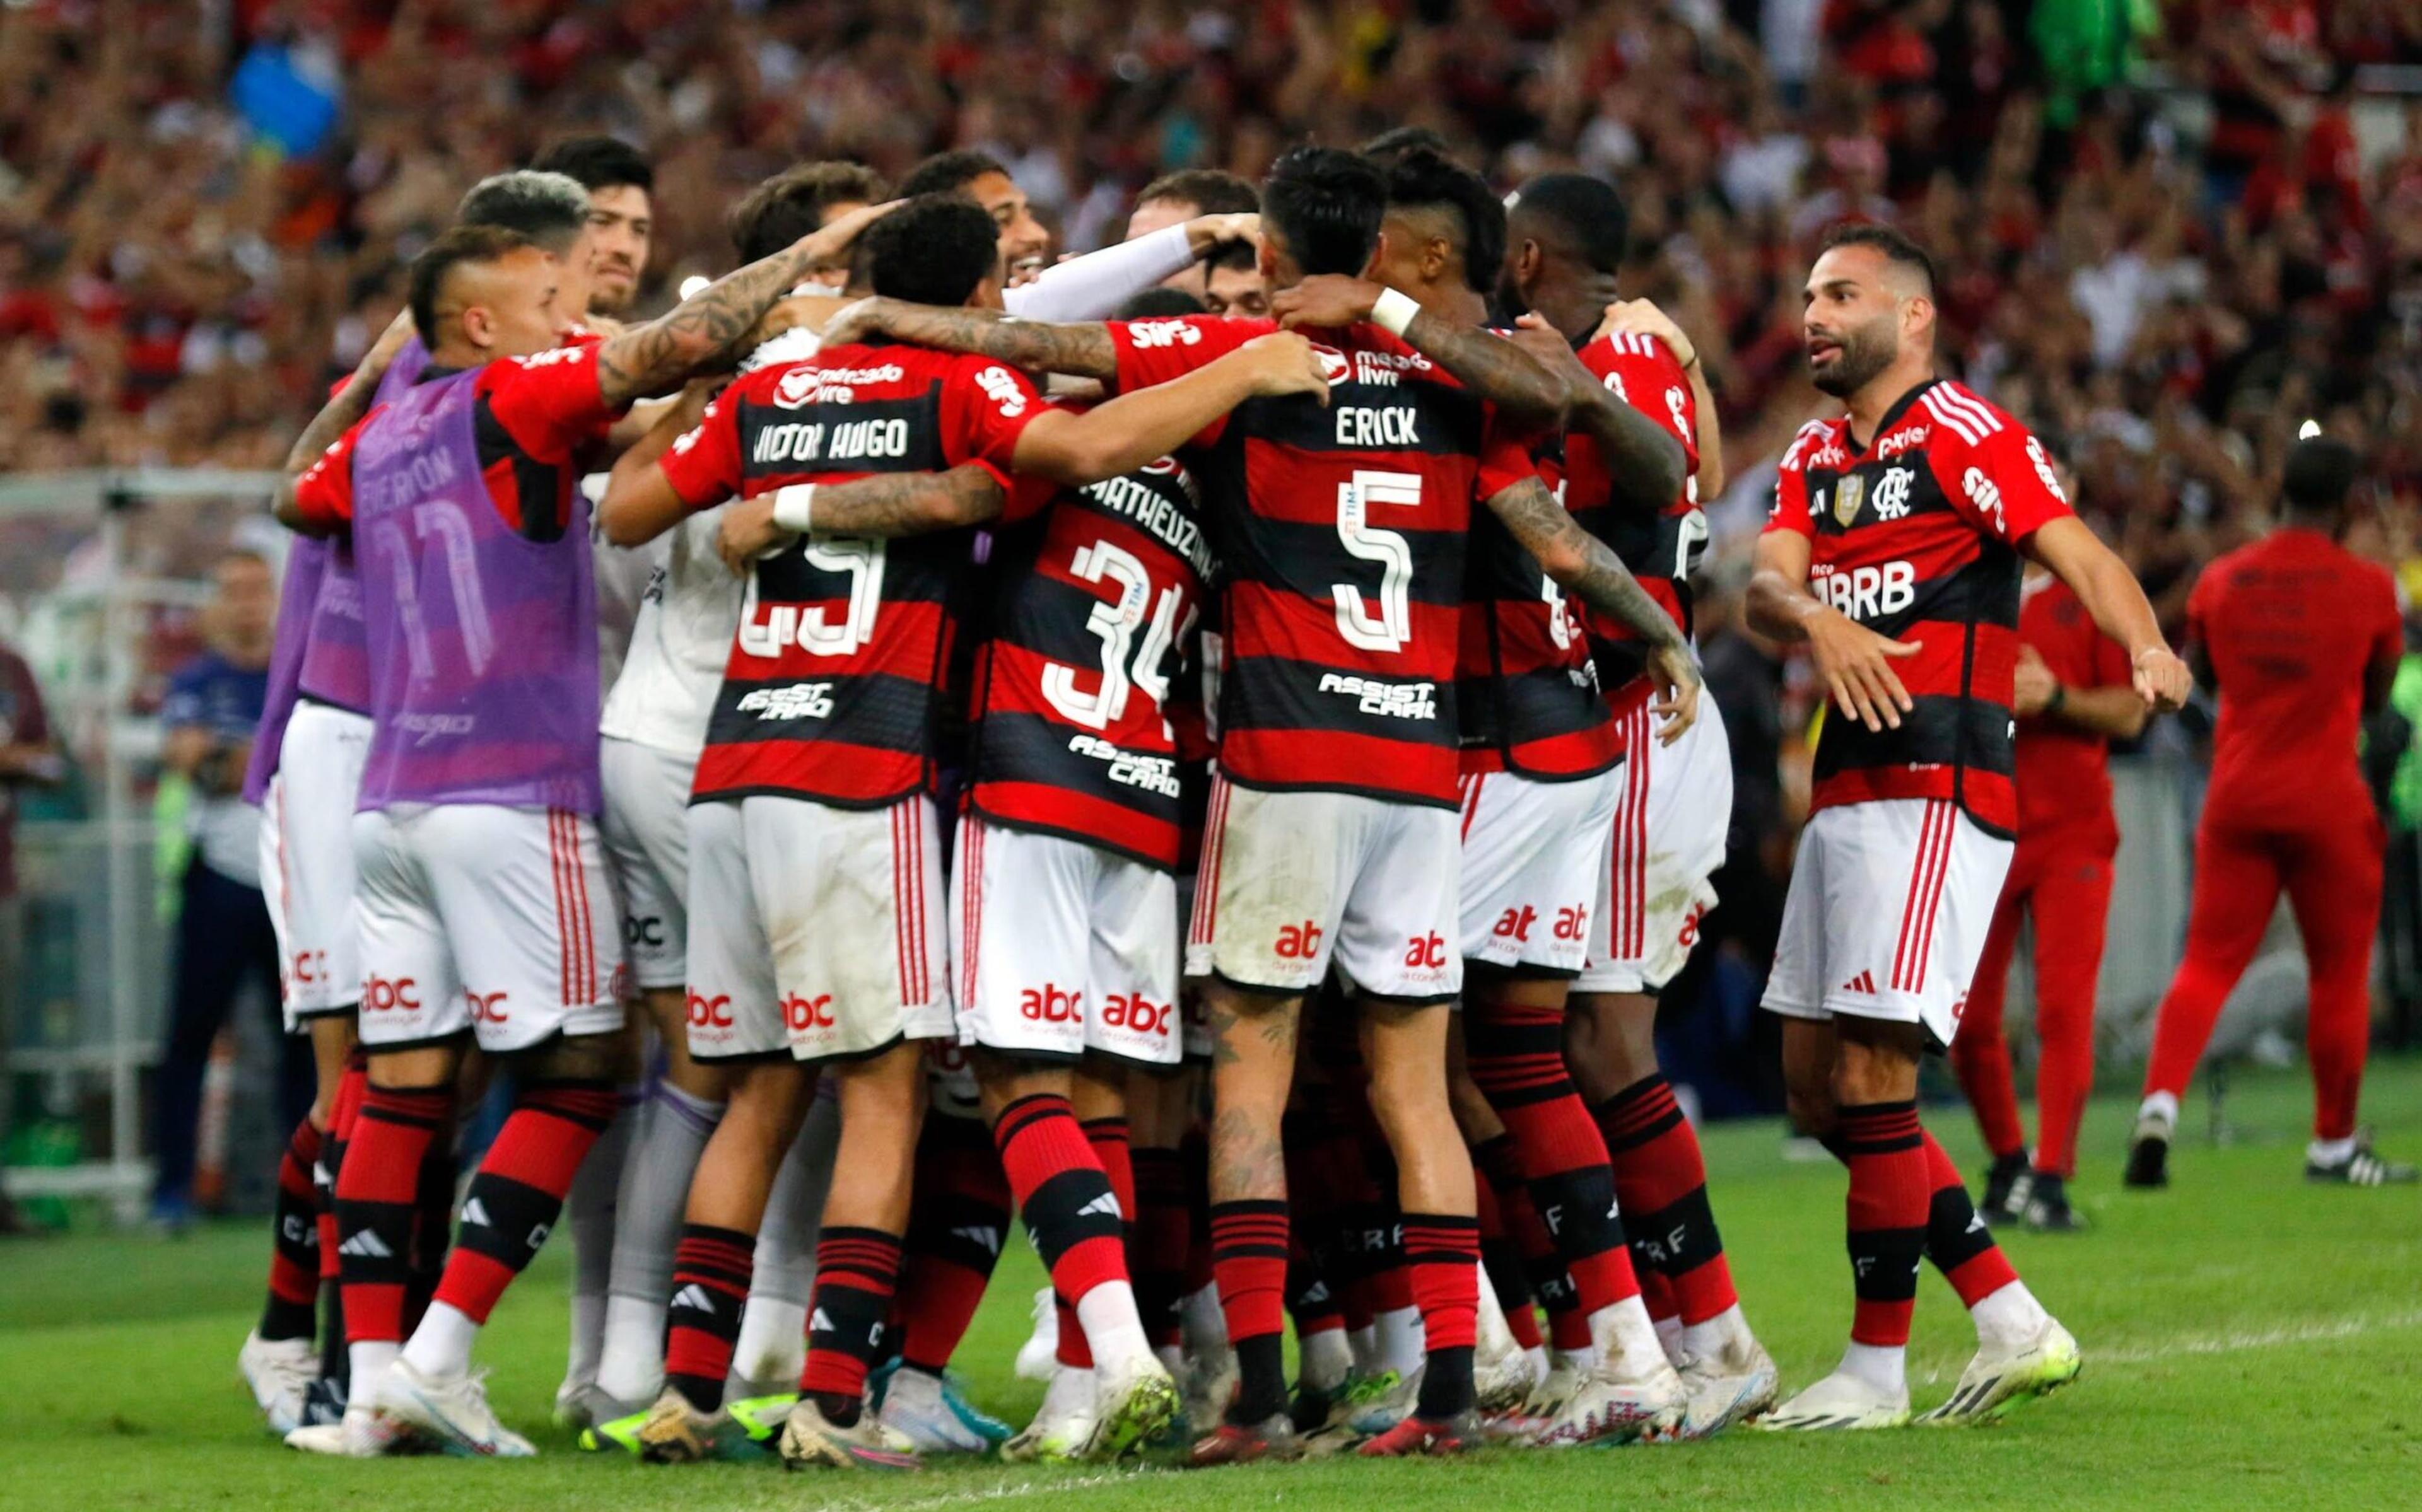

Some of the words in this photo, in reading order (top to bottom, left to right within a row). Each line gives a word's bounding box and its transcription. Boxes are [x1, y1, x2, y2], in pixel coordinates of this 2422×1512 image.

[828, 418, 908, 460] HUGO
[1336, 406, 1420, 446] ERICK
[1330, 469, 1422, 653] 5
[1811, 564, 1835, 576] nco
[1829, 560, 1915, 622] BRB
[1318, 673, 1436, 704] ASSIST
[1108, 762, 1181, 799] CARD
[1020, 983, 1083, 1023] abc
[1104, 992, 1171, 1036] abc
